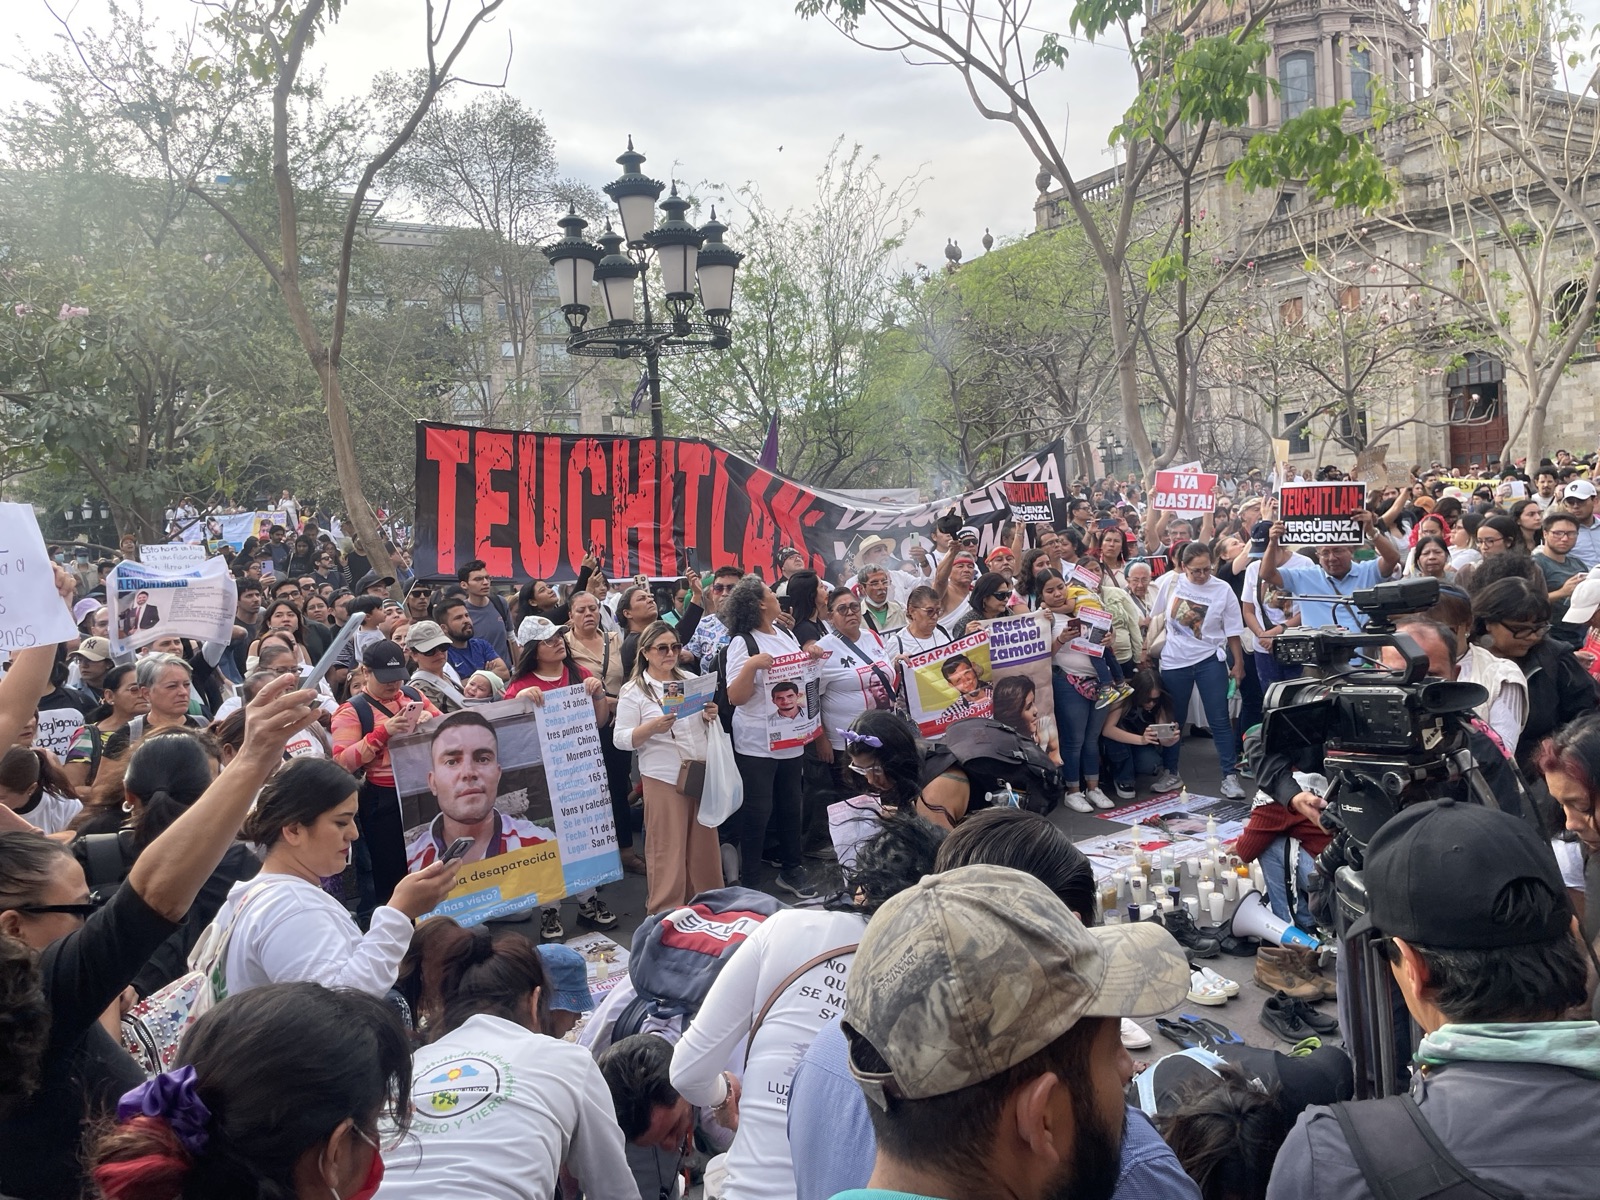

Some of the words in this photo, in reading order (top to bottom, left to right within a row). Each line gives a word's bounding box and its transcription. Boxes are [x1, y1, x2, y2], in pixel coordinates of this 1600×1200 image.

[1173, 474, 1199, 490] ¡YA
[1155, 492, 1213, 509] BASTA!
[1283, 532, 1360, 542] NACIONAL
[990, 626, 1040, 647] Michel
[907, 631, 991, 668] DESAPARECID
[990, 640, 1046, 661] Zamora
[543, 705, 562, 715] Edad:
[562, 701, 571, 710] 34
[567, 709, 595, 723] particula
[935, 707, 975, 726] RICARDO
[547, 731, 561, 740] tres
[562, 725, 583, 738] puntos
[584, 723, 593, 731] en
[566, 749, 592, 762] Morena
[588, 771, 601, 783] 165
[560, 805, 578, 817] Vans
[579, 804, 585, 814] y
[563, 820, 573, 829] Se
[565, 830, 588, 842] Fecha:
[590, 826, 599, 835] 11
[601, 823, 609, 833] de
[567, 843, 591, 855] Lugar:
[591, 838, 605, 848] San
[470, 851, 557, 882] desaparecida
[443, 902, 464, 914] has
[466, 889, 498, 907] visto?
[824, 959, 847, 974] NO
[799, 986, 822, 1000] SE
[454, 1118, 463, 1129] Y
